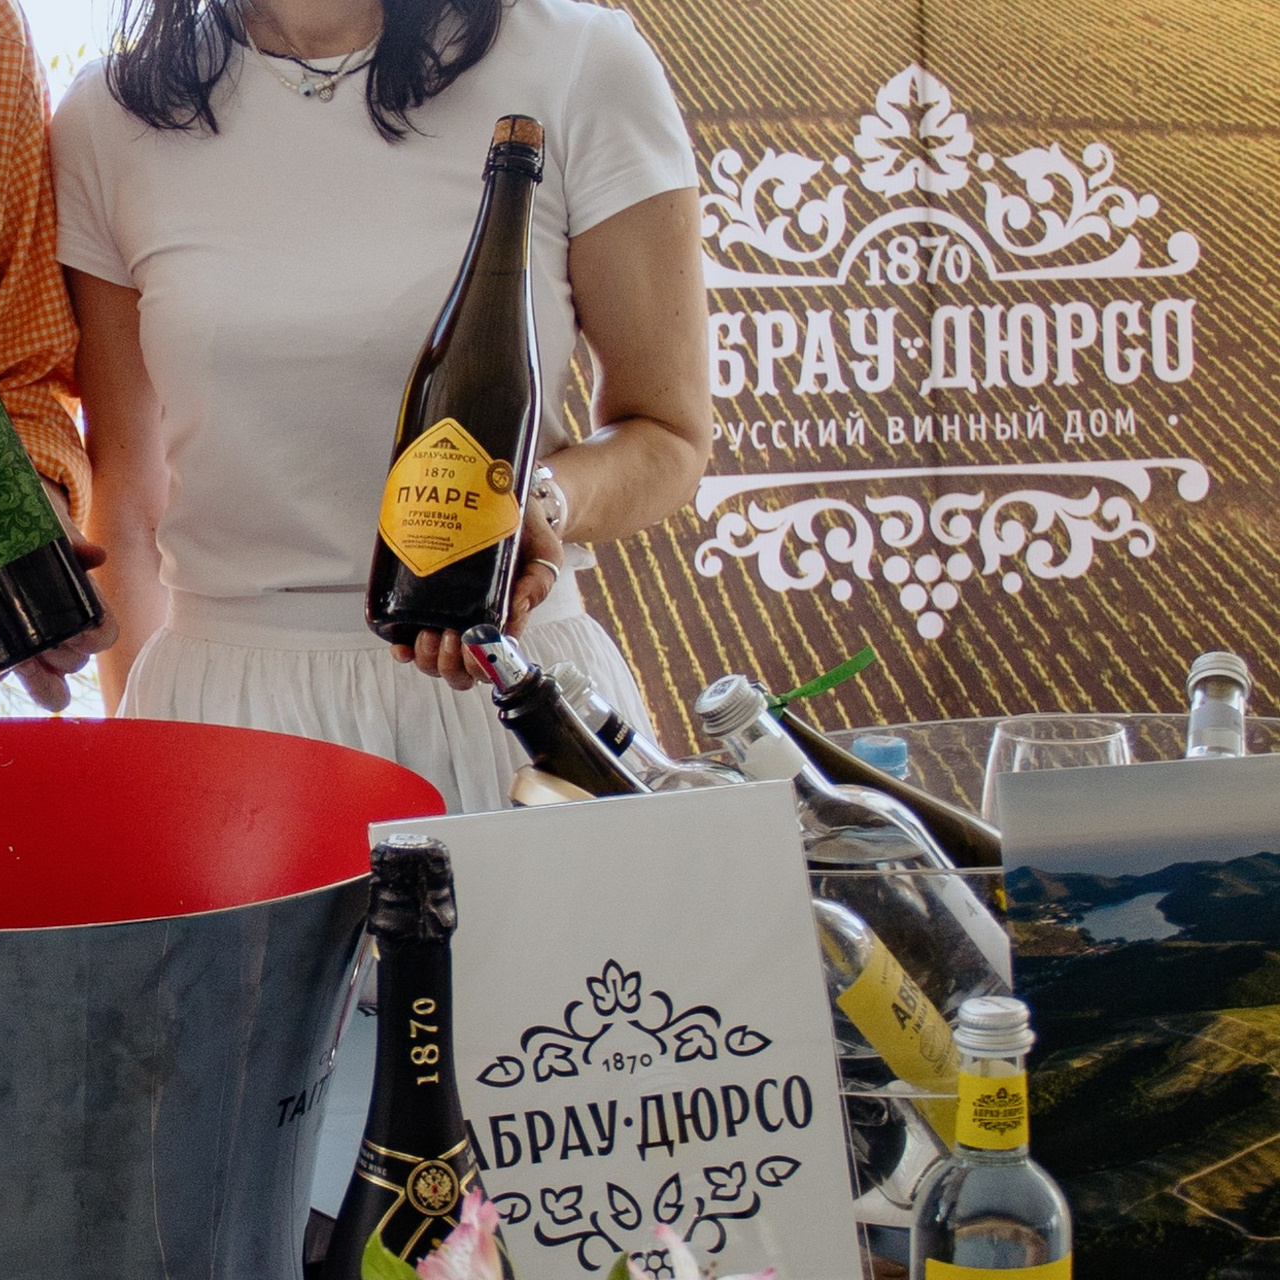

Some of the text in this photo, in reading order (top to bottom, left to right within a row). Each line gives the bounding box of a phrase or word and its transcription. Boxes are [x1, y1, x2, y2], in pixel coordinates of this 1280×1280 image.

[864, 235, 972, 287] 1870
[708, 297, 1197, 400] БРАУ·ДЮРСО
[887, 405, 1046, 446] ВИННЫЙ
[1063, 407, 1137, 443] ДОМ
[425, 467, 455, 479] 1870
[397, 486, 481, 510] ПУАРЕ
[402, 519, 462, 531] ПОЛУСУХОЙ
[409, 510, 458, 522] ГРУШЕВЫЙ
[410, 997, 439, 1086] 1870
[602, 1052, 653, 1075] 1870
